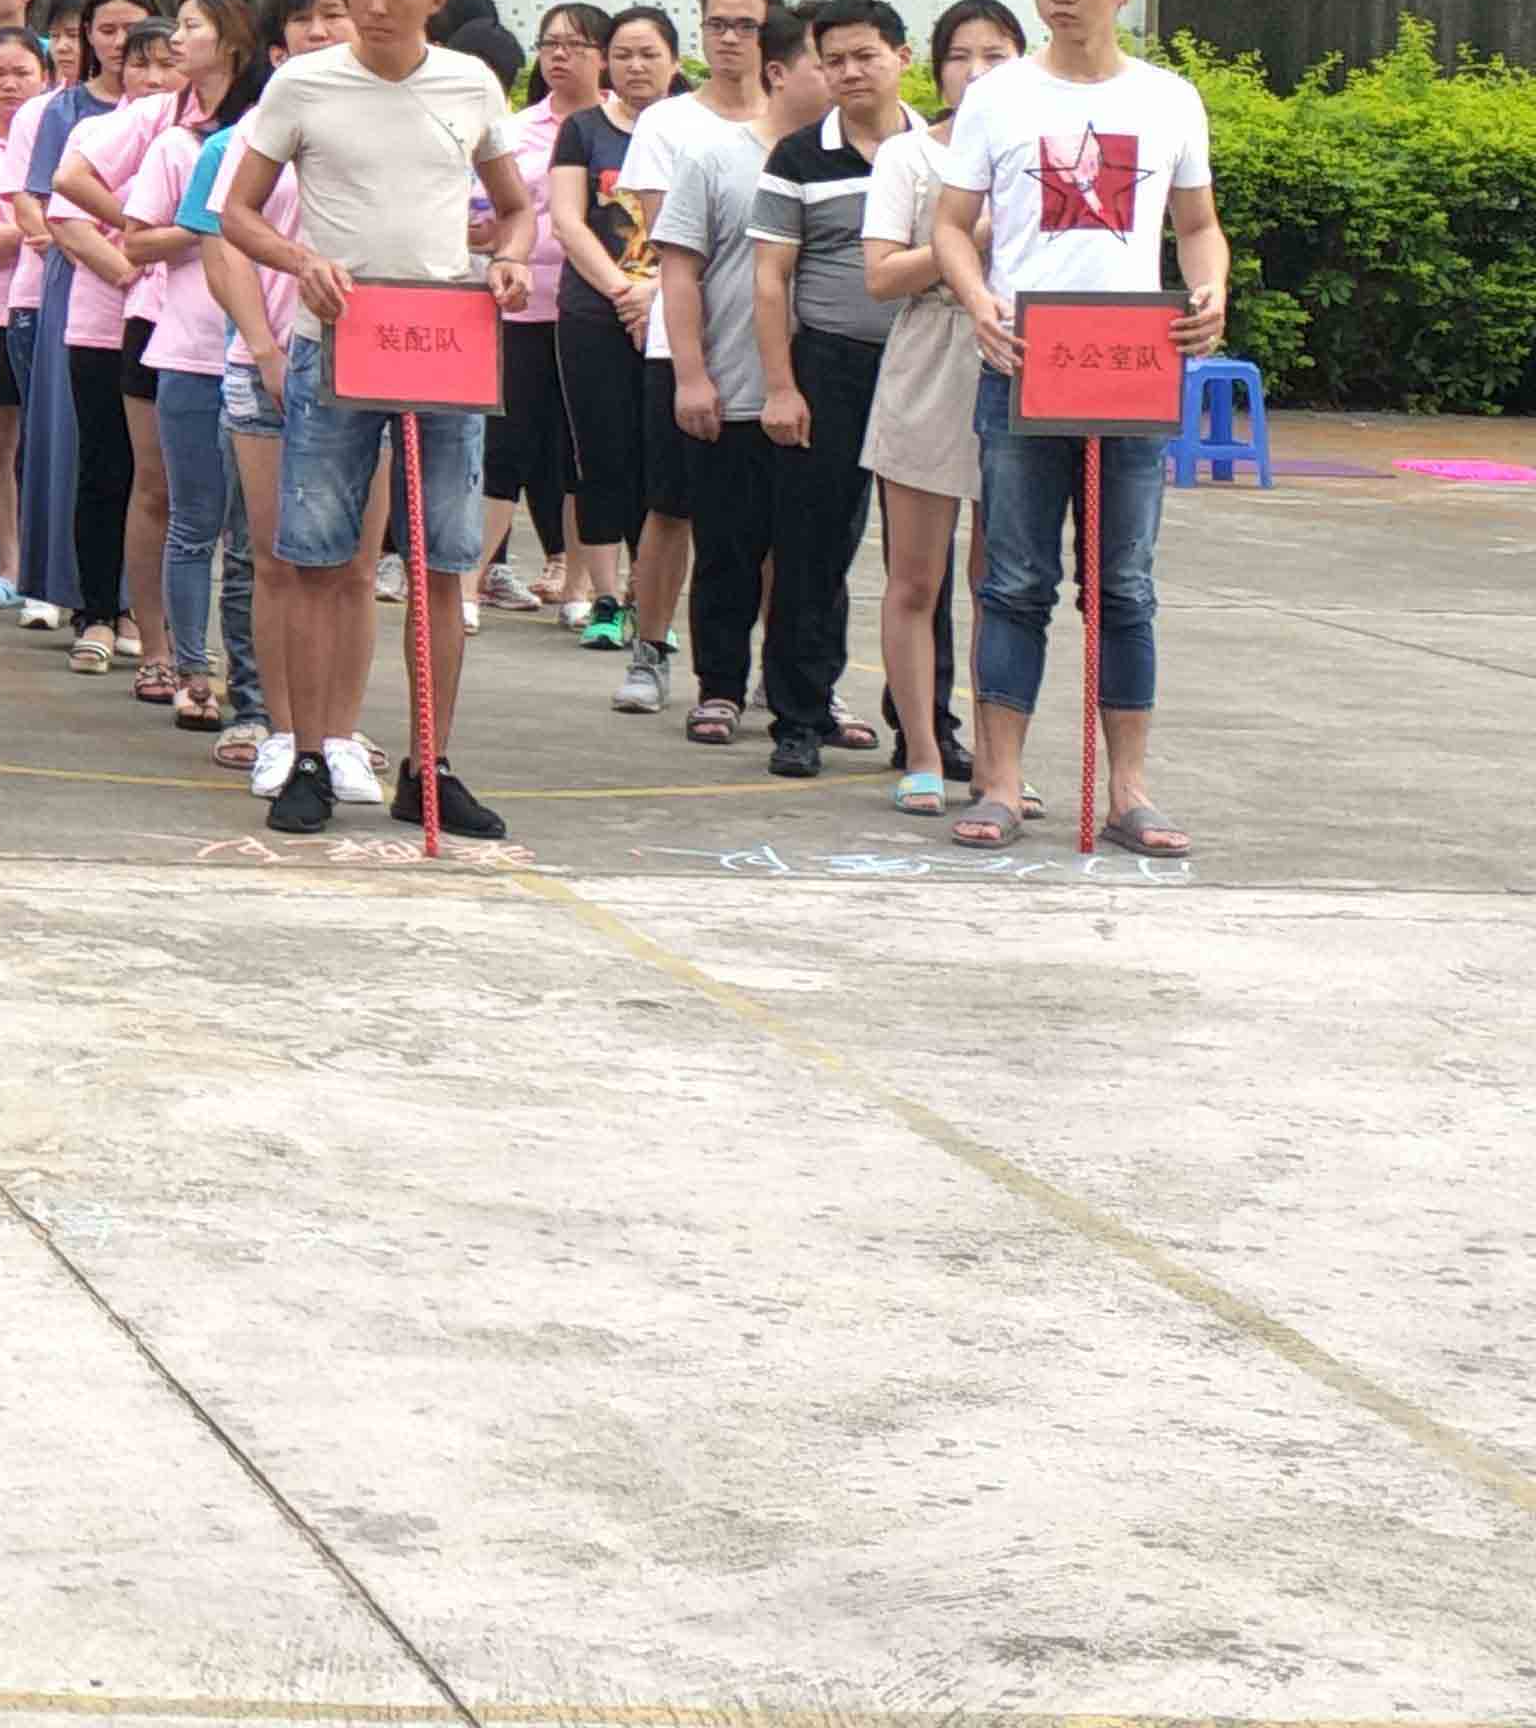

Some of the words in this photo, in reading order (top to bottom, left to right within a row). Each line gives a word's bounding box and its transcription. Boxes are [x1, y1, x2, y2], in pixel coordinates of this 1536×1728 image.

[376, 324, 463, 353] 装配队
[1049, 343, 1163, 371] 办公室队
